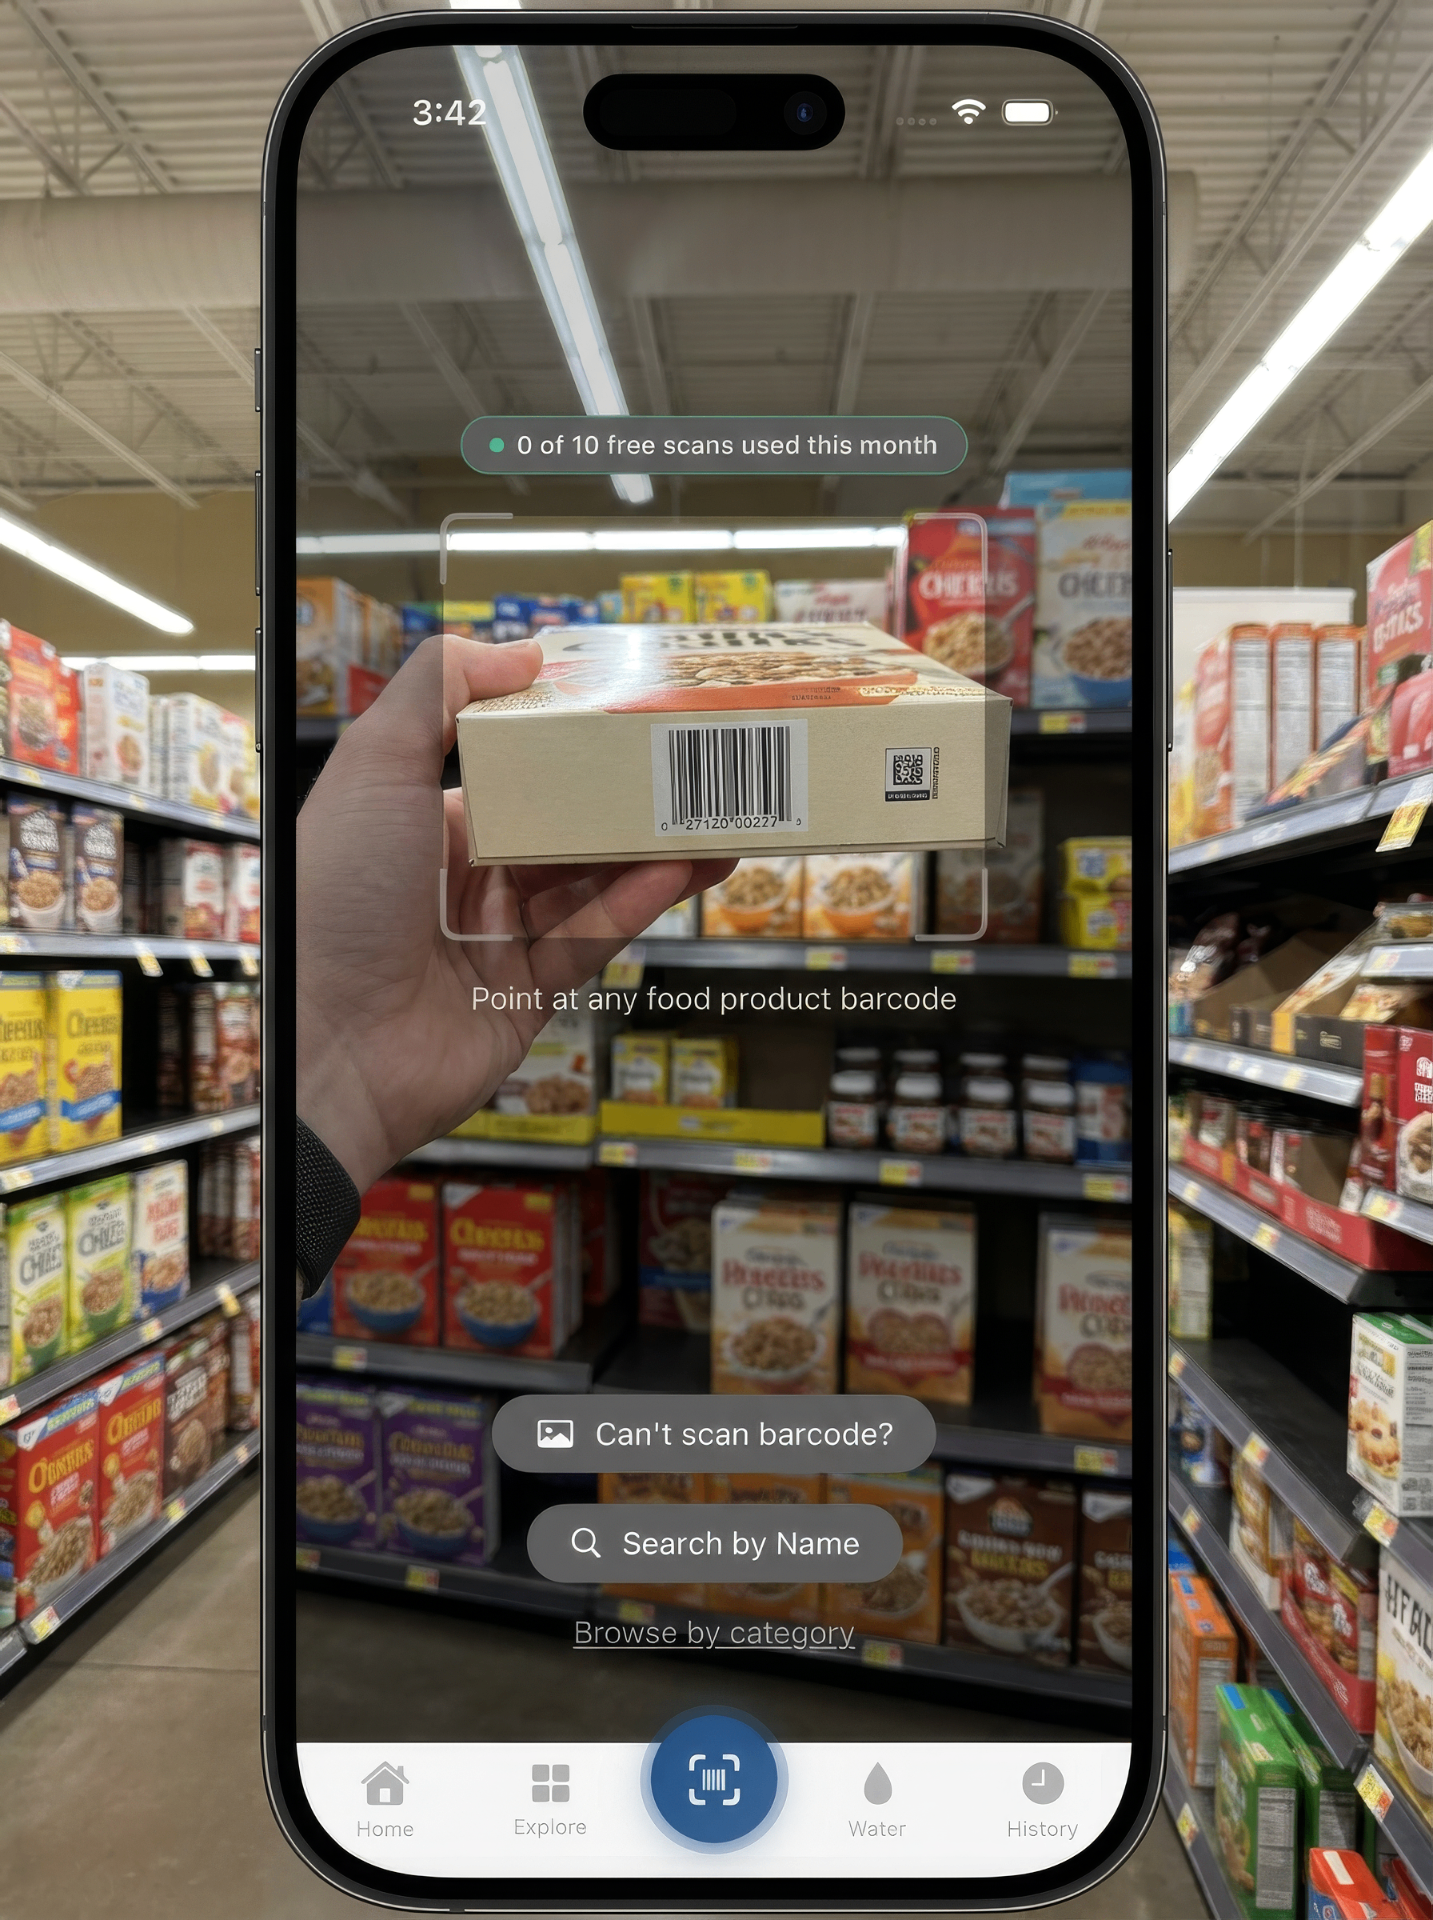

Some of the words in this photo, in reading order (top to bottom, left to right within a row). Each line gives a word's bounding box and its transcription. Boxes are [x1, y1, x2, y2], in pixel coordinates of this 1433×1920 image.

[413, 98, 487, 126] 3:42
[517, 436, 531, 455] 0
[541, 434, 564, 455] of
[572, 435, 599, 455] 10
[606, 434, 656, 455] free
[663, 439, 734, 455] scans
[742, 434, 800, 455] used
[807, 434, 852, 455] this
[860, 434, 937, 455] month
[660, 821, 669, 832] 0
[685, 817, 729, 831] 27120
[734, 815, 778, 830] 00227
[472, 986, 543, 1011] Point
[552, 988, 579, 1011] at
[588, 992, 638, 1017] any
[646, 986, 710, 1010] food
[721, 986, 832, 1016] product
[841, 986, 957, 1010] barcode
[596, 1421, 672, 1447] Can't
[682, 1427, 749, 1447] scan
[760, 1421, 893, 1447] barcode?
[623, 1530, 722, 1556] Search
[733, 1530, 767, 1561] by
[777, 1531, 860, 1556] Name
[574, 1620, 677, 1645] Browse
[688, 1620, 720, 1650] by
[730, 1620, 856, 1650] category
[356, 1820, 414, 1837] Home
[514, 1818, 587, 1839] Explore
[848, 1820, 907, 1837] Water
[1007, 1820, 1079, 1842] History
